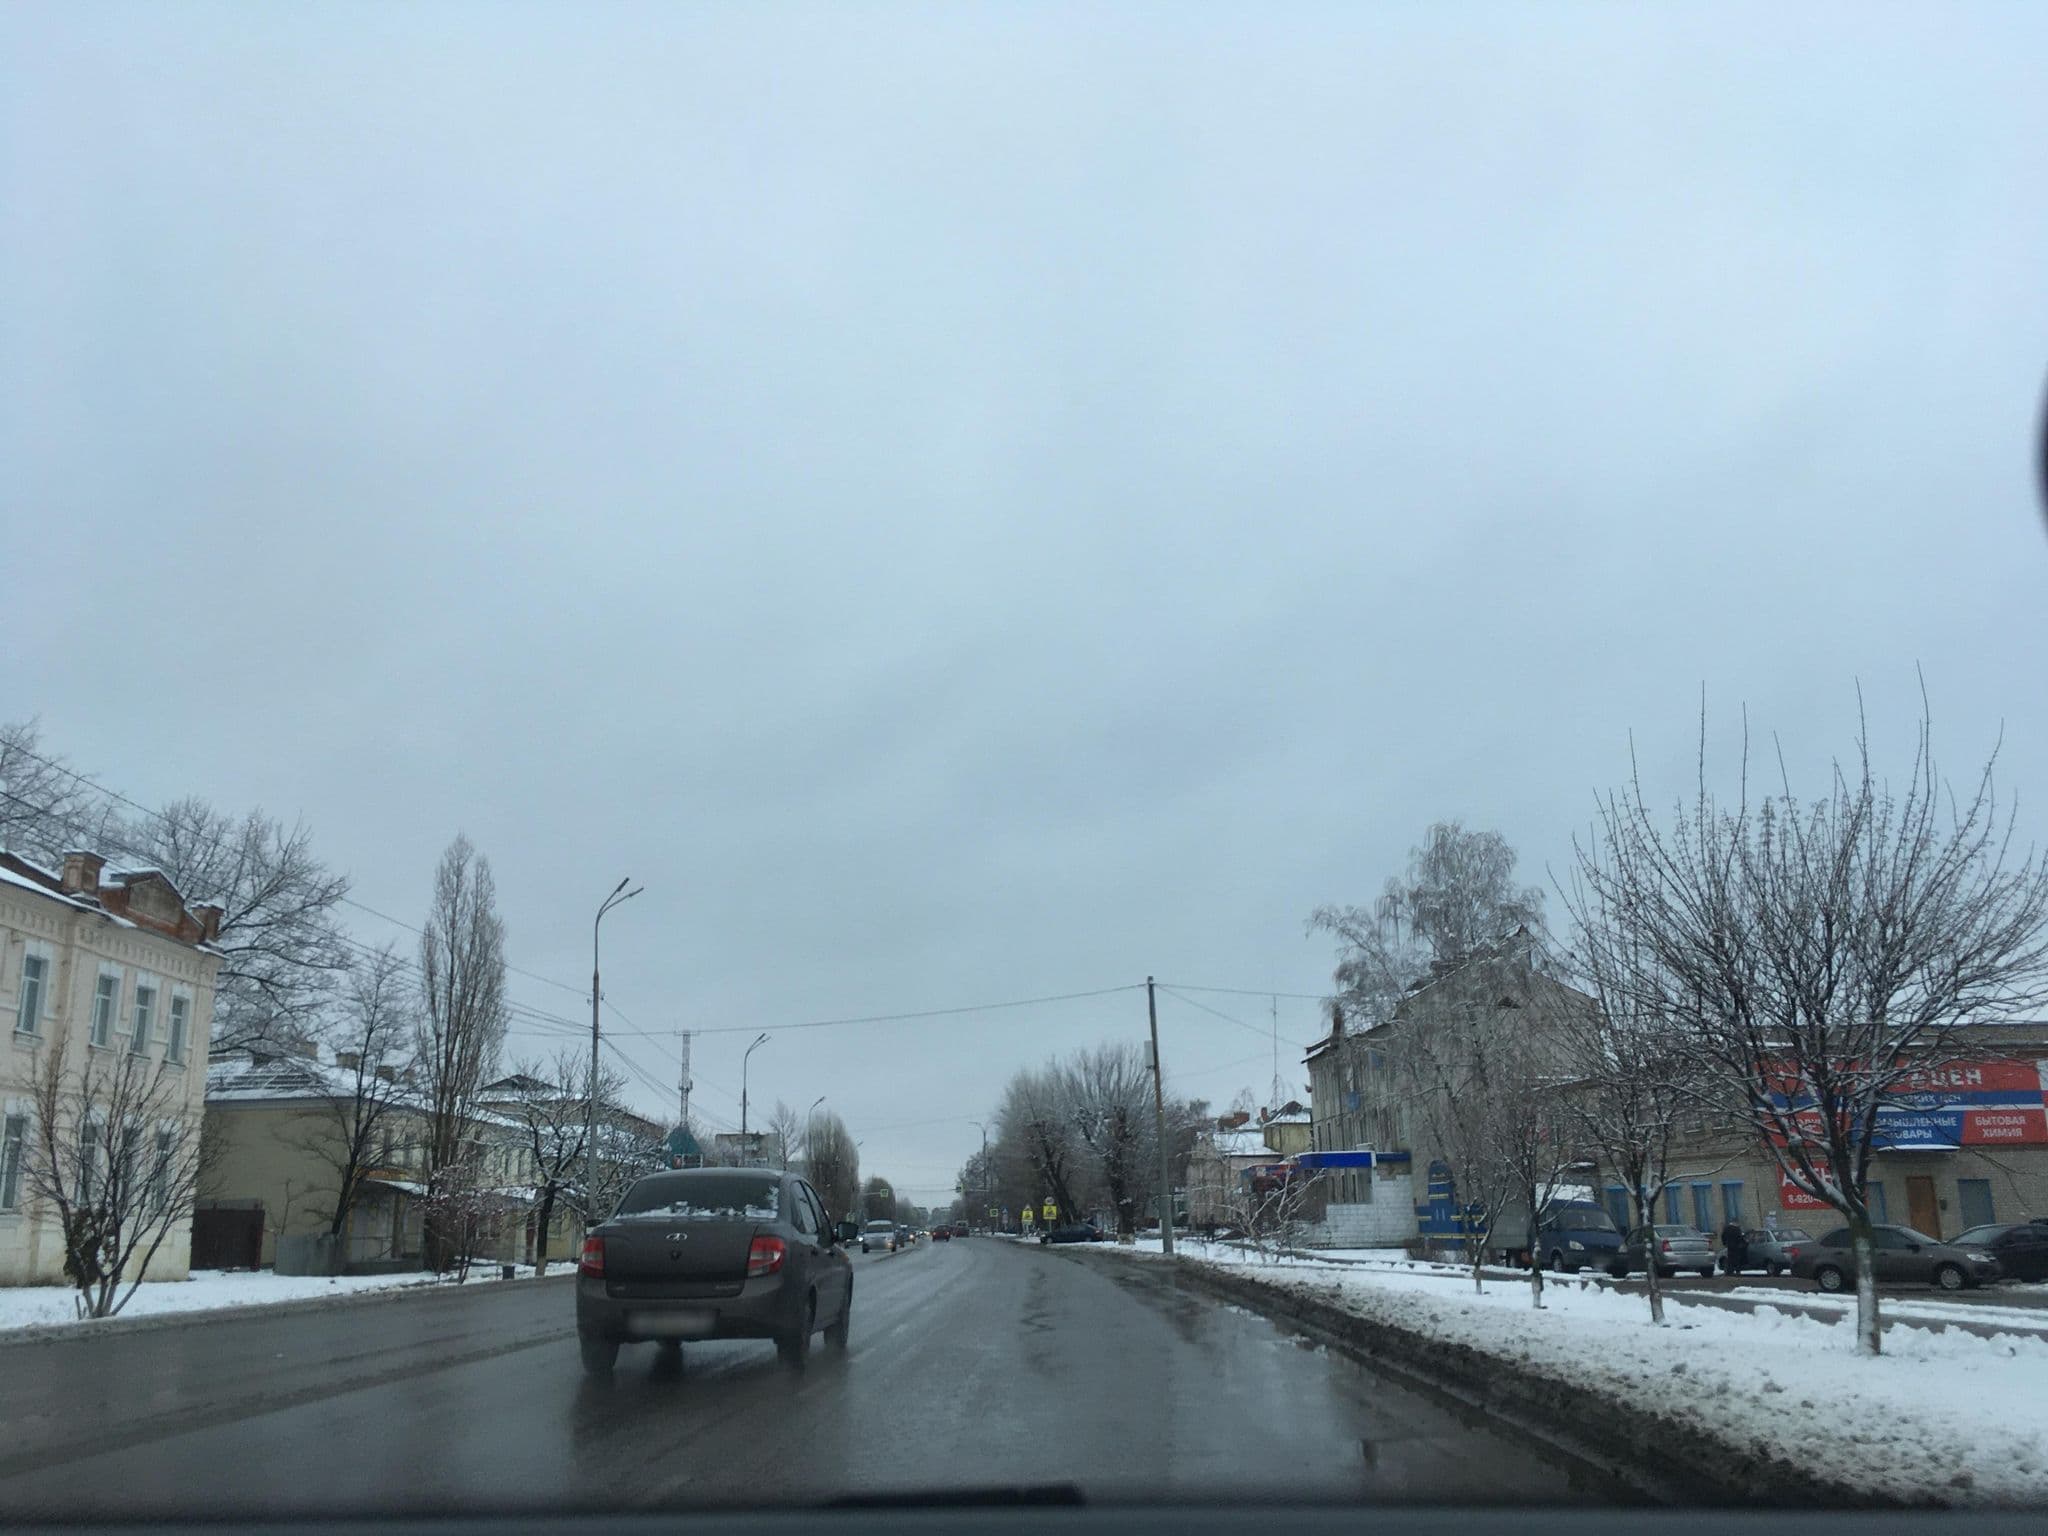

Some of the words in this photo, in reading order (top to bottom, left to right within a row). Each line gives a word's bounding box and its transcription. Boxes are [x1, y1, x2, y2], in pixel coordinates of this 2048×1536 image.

[1975, 1115, 2026, 1126] БЫТОВАЯ
[1891, 1129, 1932, 1140] ОВАРЫ
[1982, 1127, 2022, 1138] ХИМИЯ
